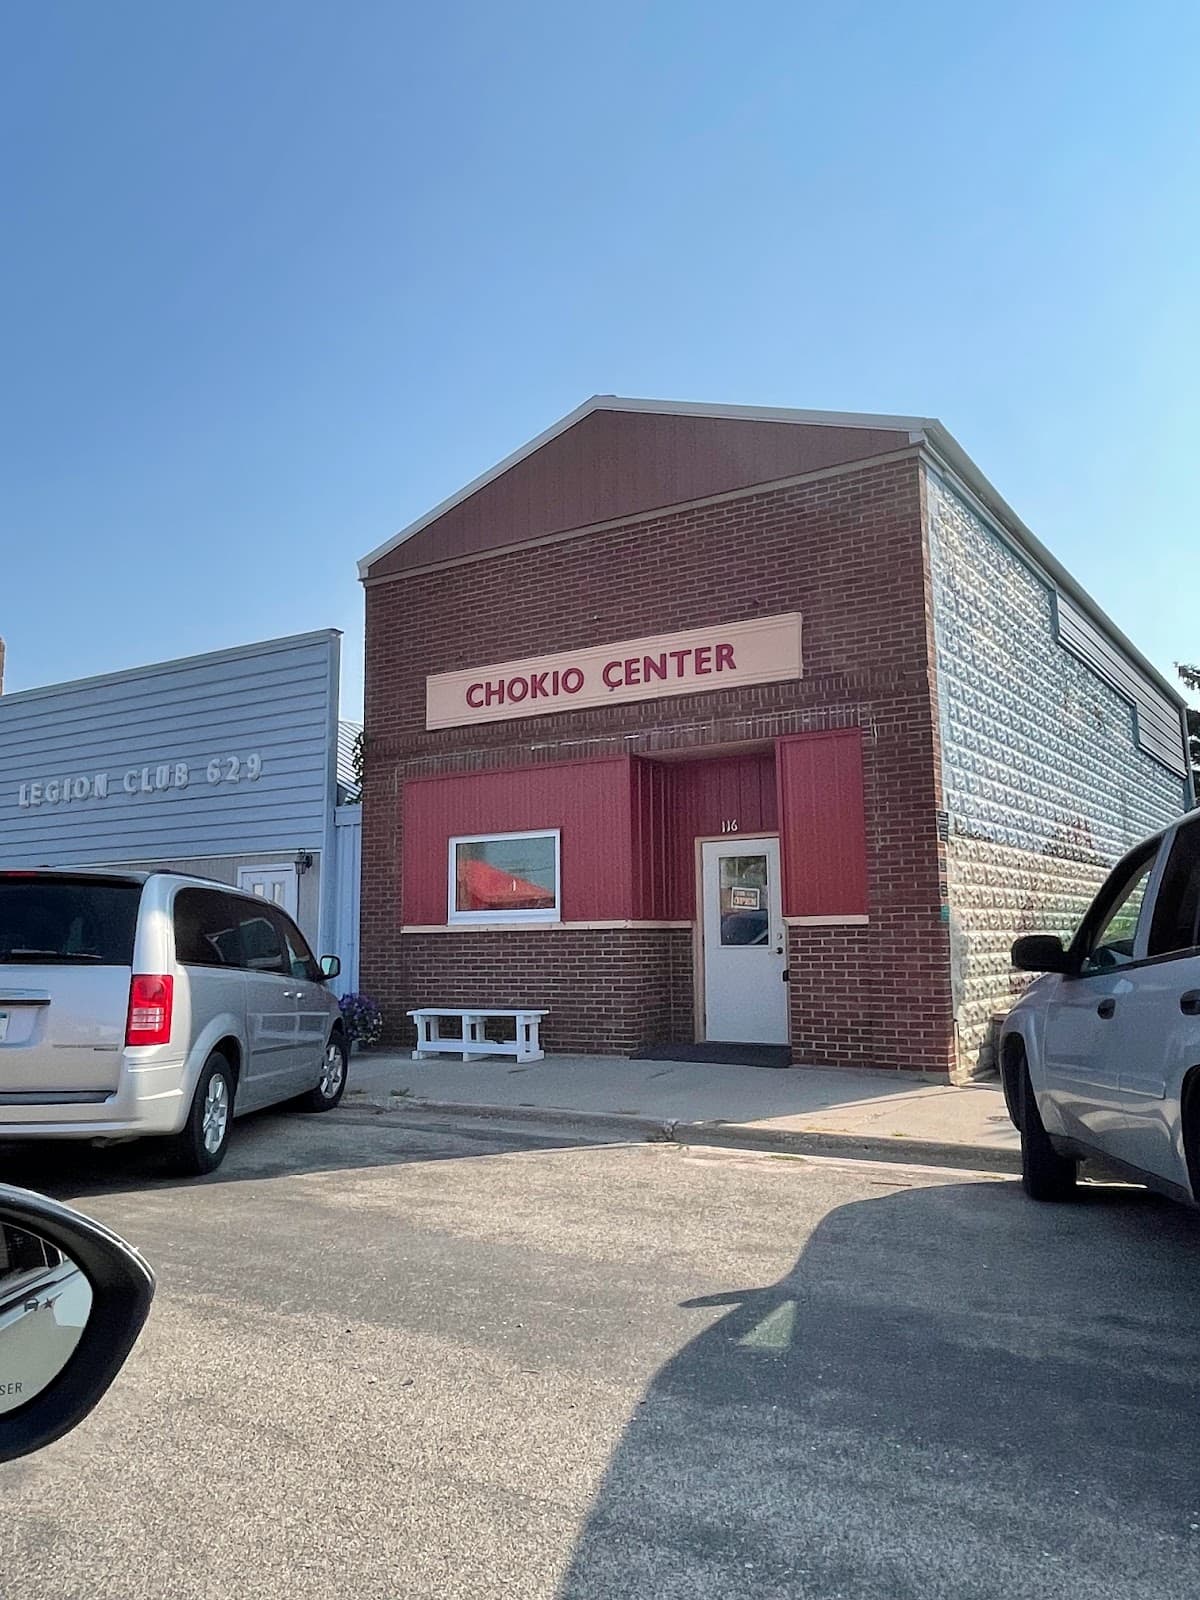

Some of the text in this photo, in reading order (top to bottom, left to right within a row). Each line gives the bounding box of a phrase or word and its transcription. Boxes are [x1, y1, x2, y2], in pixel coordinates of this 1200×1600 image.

[465, 643, 736, 708] CHOKIO CENTER
[18, 753, 263, 808] LEGION CLUB 629
[721, 819, 738, 832] 116
